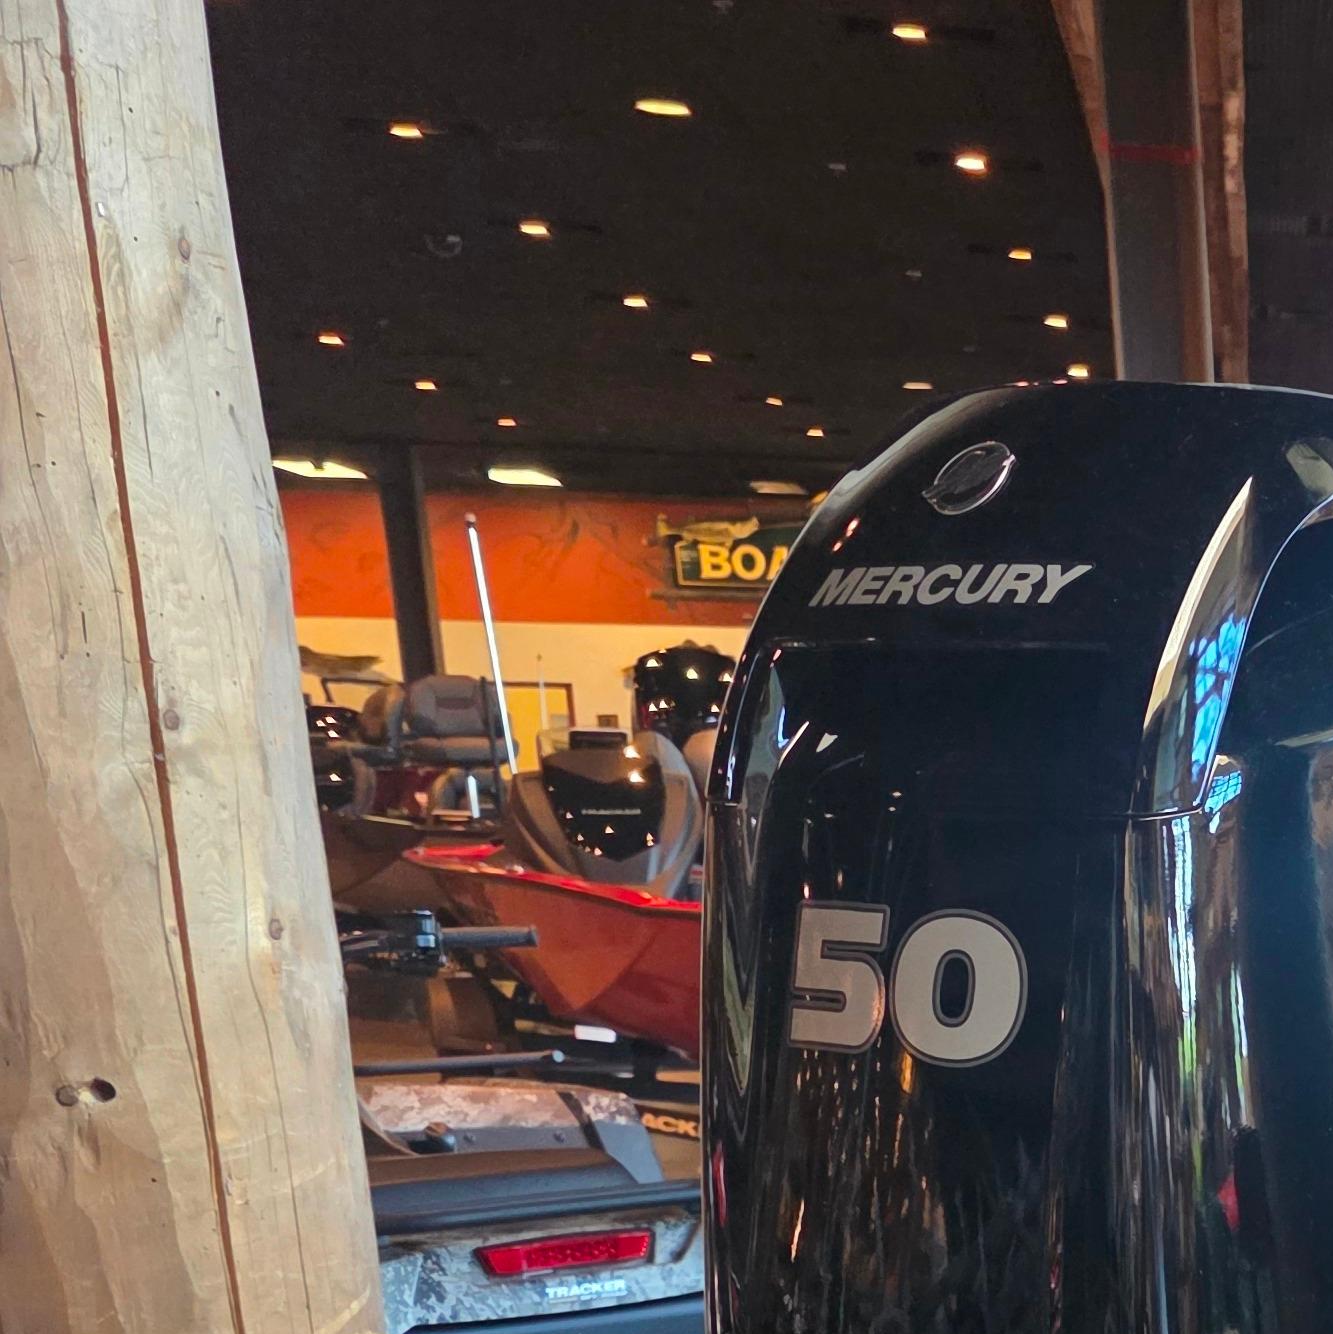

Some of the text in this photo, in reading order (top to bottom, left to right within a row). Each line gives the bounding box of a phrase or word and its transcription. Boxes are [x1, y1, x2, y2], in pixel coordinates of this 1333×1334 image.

[809, 563, 1095, 608] MERCURY
[788, 902, 1028, 1067] 50
[545, 1279, 626, 1299] TRACKER
